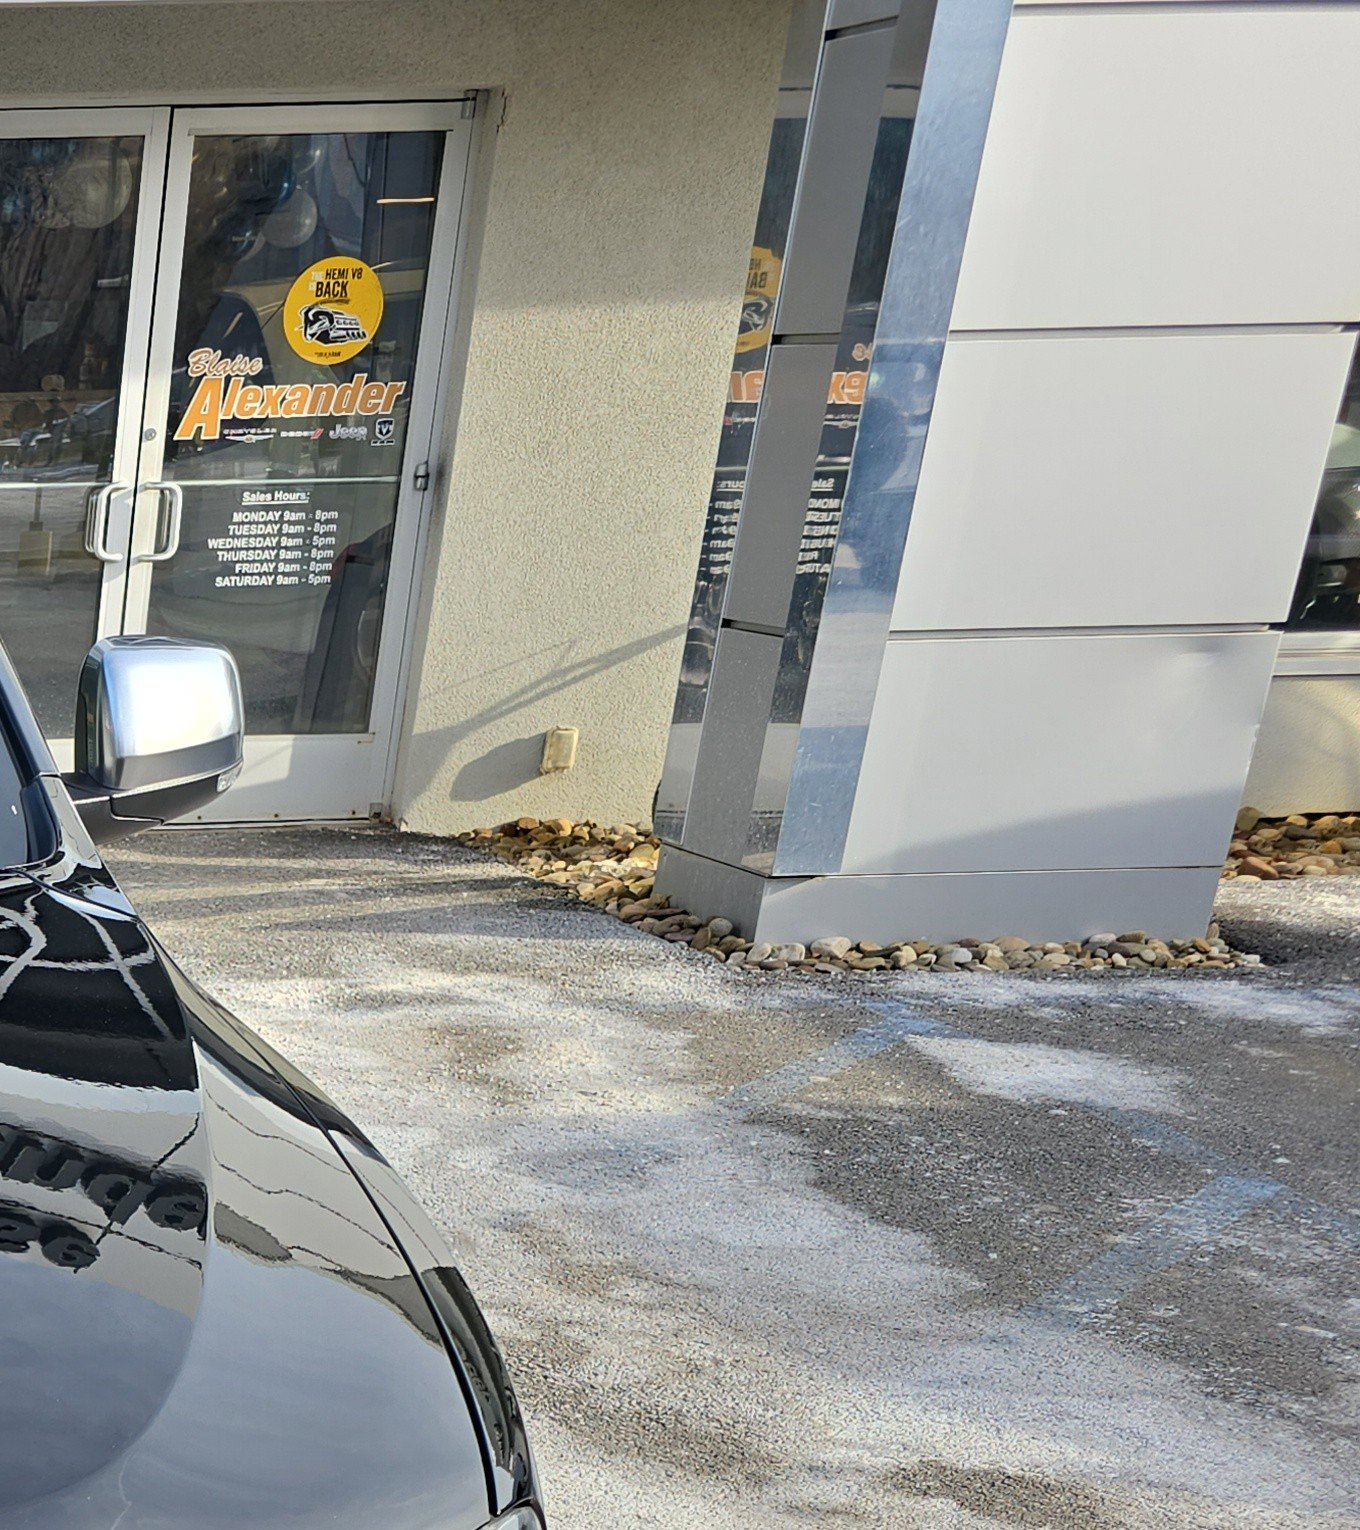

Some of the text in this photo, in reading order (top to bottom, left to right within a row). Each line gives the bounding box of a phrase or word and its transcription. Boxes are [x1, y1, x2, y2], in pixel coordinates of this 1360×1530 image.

[324, 267, 349, 280] HEMI
[351, 266, 363, 280] V8
[315, 280, 349, 298] BACK
[188, 347, 264, 377] Blaise
[173, 373, 407, 442] Alexander
[329, 424, 367, 441] Jeep
[242, 490, 310, 502] Sales Hours:
[232, 510, 282, 523] MONDAY
[283, 510, 306, 521] 9am
[315, 509, 338, 522] 8pm
[228, 523, 280, 535] TUESDAY
[282, 523, 305, 534] 9am
[314, 522, 337, 534] 8pm
[207, 537, 279, 549] WEDNESDAY
[280, 537, 303, 547] 9am
[312, 535, 336, 547] 5pm
[217, 550, 278, 562] THURSDAY
[279, 549, 302, 560] 9am
[311, 548, 334, 560] 8pm
[235, 563, 276, 574] FRIDAY
[277, 562, 300, 573] 9am
[309, 561, 333, 573] 8pm
[215, 575, 275, 588] SATURDAY
[276, 575, 299, 585] 9am
[308, 574, 331, 586] 5pm
